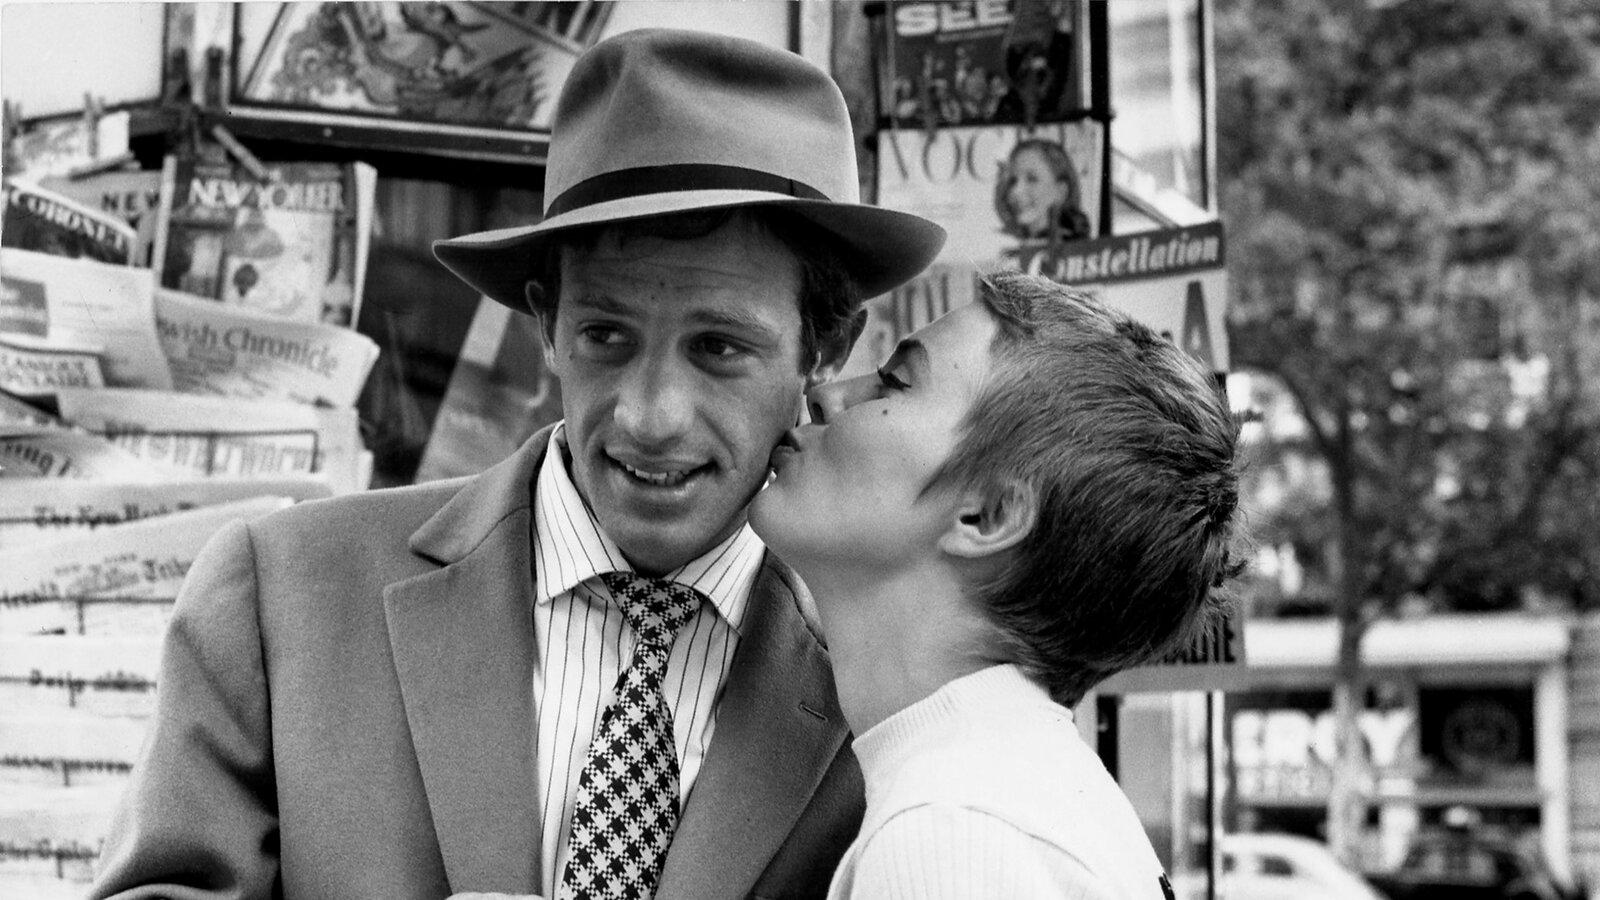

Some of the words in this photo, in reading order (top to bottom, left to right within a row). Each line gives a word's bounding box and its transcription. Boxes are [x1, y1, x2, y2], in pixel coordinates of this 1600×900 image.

[895, 0, 1014, 36] SEE
[188, 177, 250, 208] NEW
[223, 326, 339, 379] Chronicle
